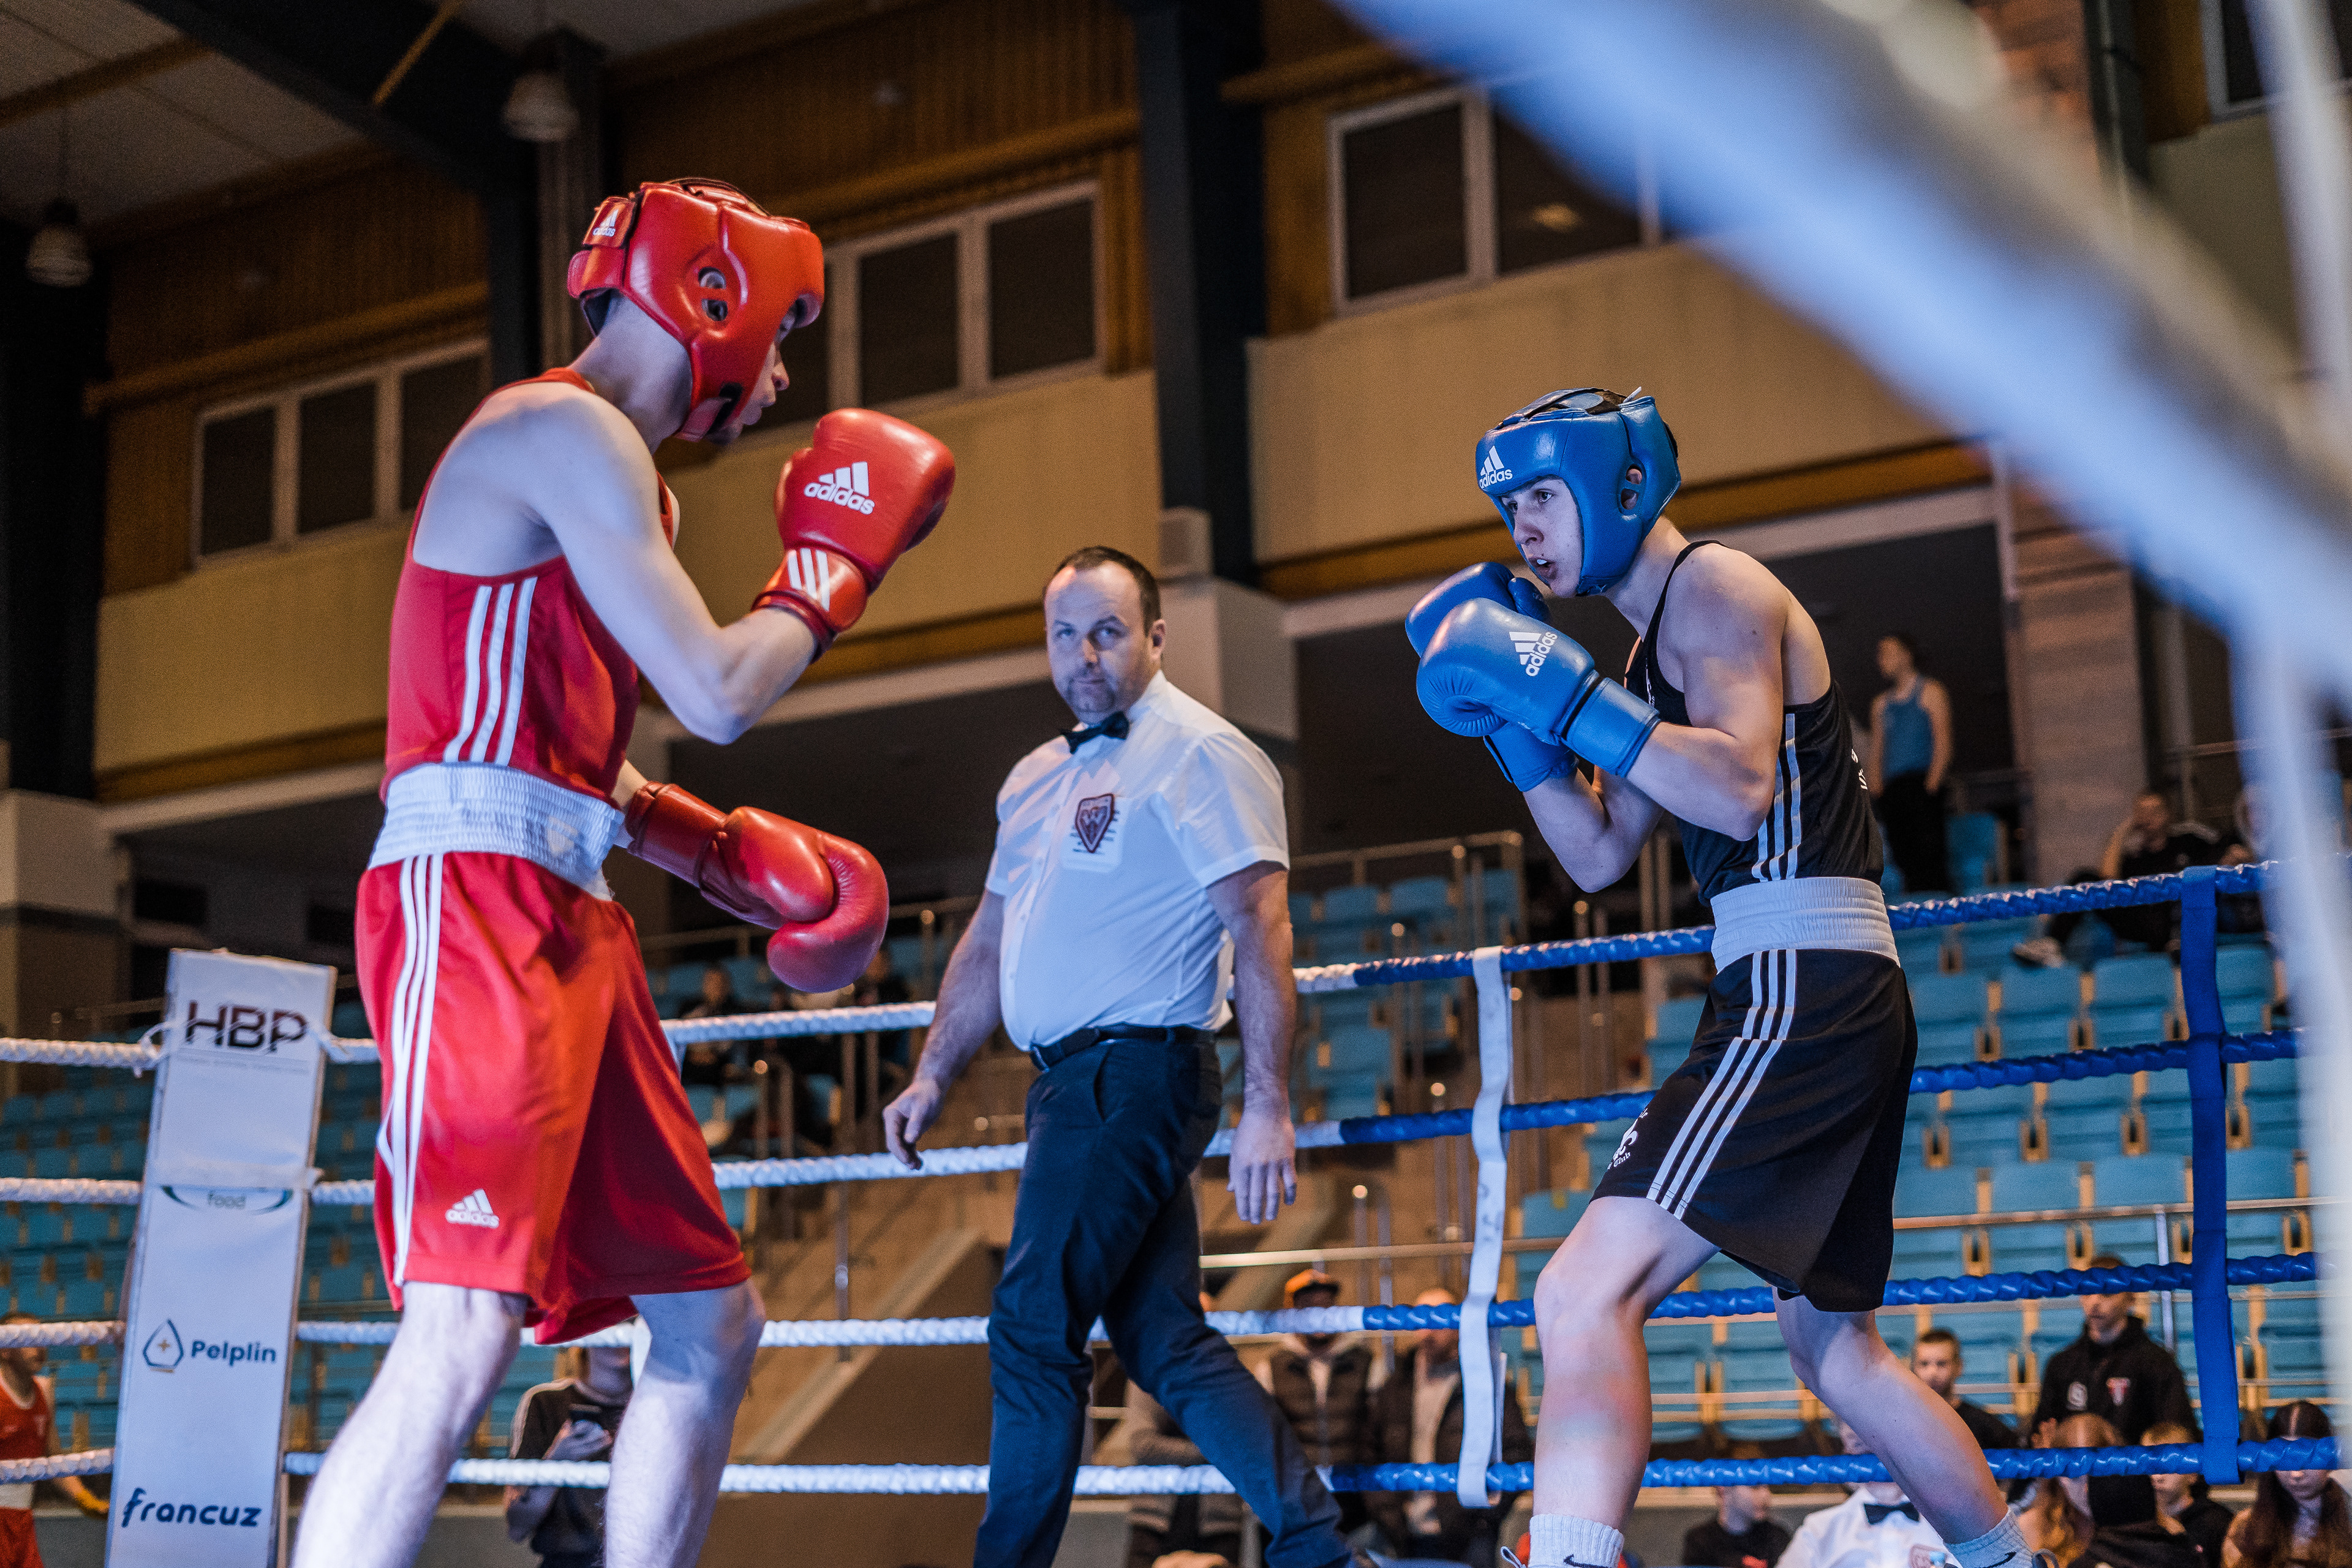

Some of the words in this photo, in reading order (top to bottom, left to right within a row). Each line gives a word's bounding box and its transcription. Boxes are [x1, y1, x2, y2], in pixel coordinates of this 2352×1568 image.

[1479, 469, 1513, 489] adidas
[804, 482, 875, 514] adidas
[1526, 632, 1558, 677] adidas
[186, 1000, 307, 1052] HBP
[445, 1208, 500, 1229] adidas
[191, 1340, 276, 1367] Pelplin
[121, 1487, 262, 1528] francuz
